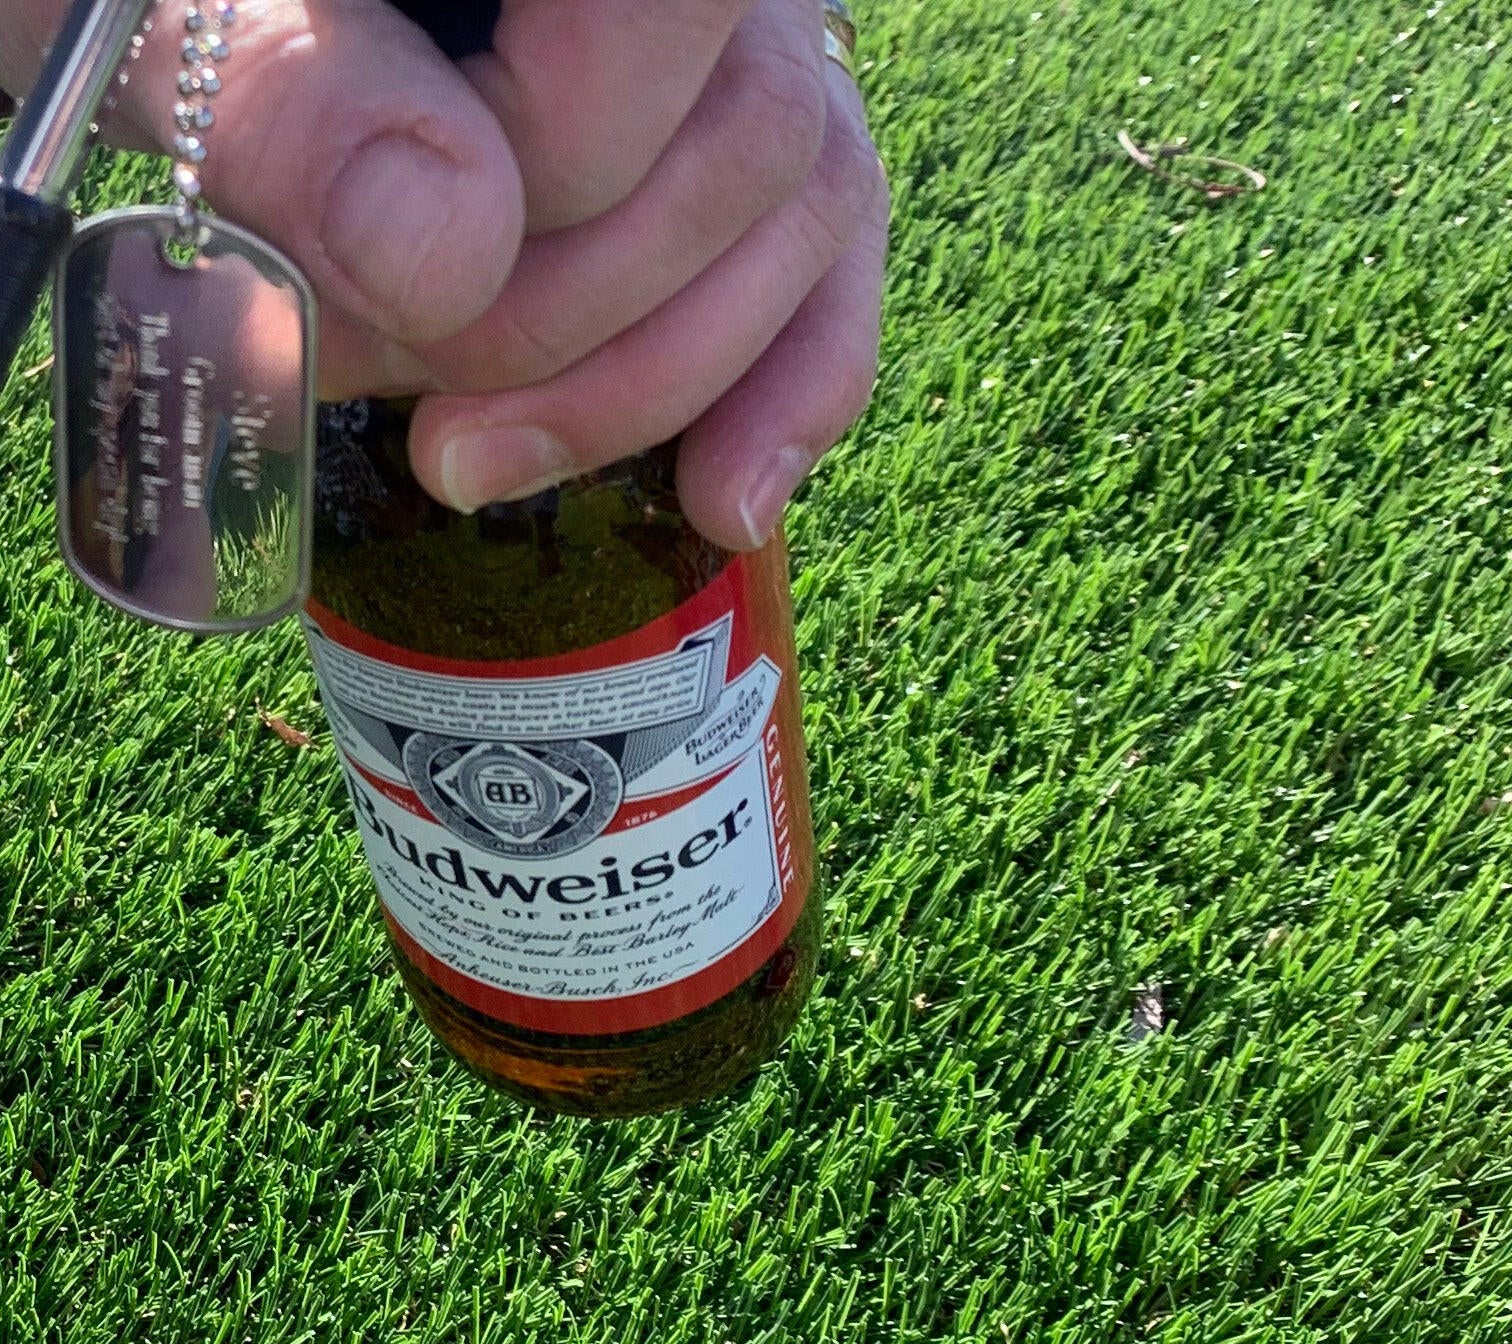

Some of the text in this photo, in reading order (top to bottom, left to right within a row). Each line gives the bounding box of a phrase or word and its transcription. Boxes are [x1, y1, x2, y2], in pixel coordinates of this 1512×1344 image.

[346, 766, 749, 905] Budweiser
[766, 723, 795, 894] GENUINE
[418, 875, 487, 913] KING
[501, 907, 542, 921] OF
[463, 917, 493, 932] our
[496, 928, 574, 945] original
[573, 921, 644, 949] process
[647, 909, 692, 933] from
[697, 883, 722, 906] the
[522, 946, 566, 958] and
[567, 942, 622, 959] Best
[622, 922, 692, 951] Barley
[693, 884, 745, 923] Malt
[480, 955, 514, 971] AND
[517, 963, 598, 977] BOTTLED
[601, 964, 619, 975] IN
[625, 955, 658, 970] THE
[662, 941, 695, 959] USA
